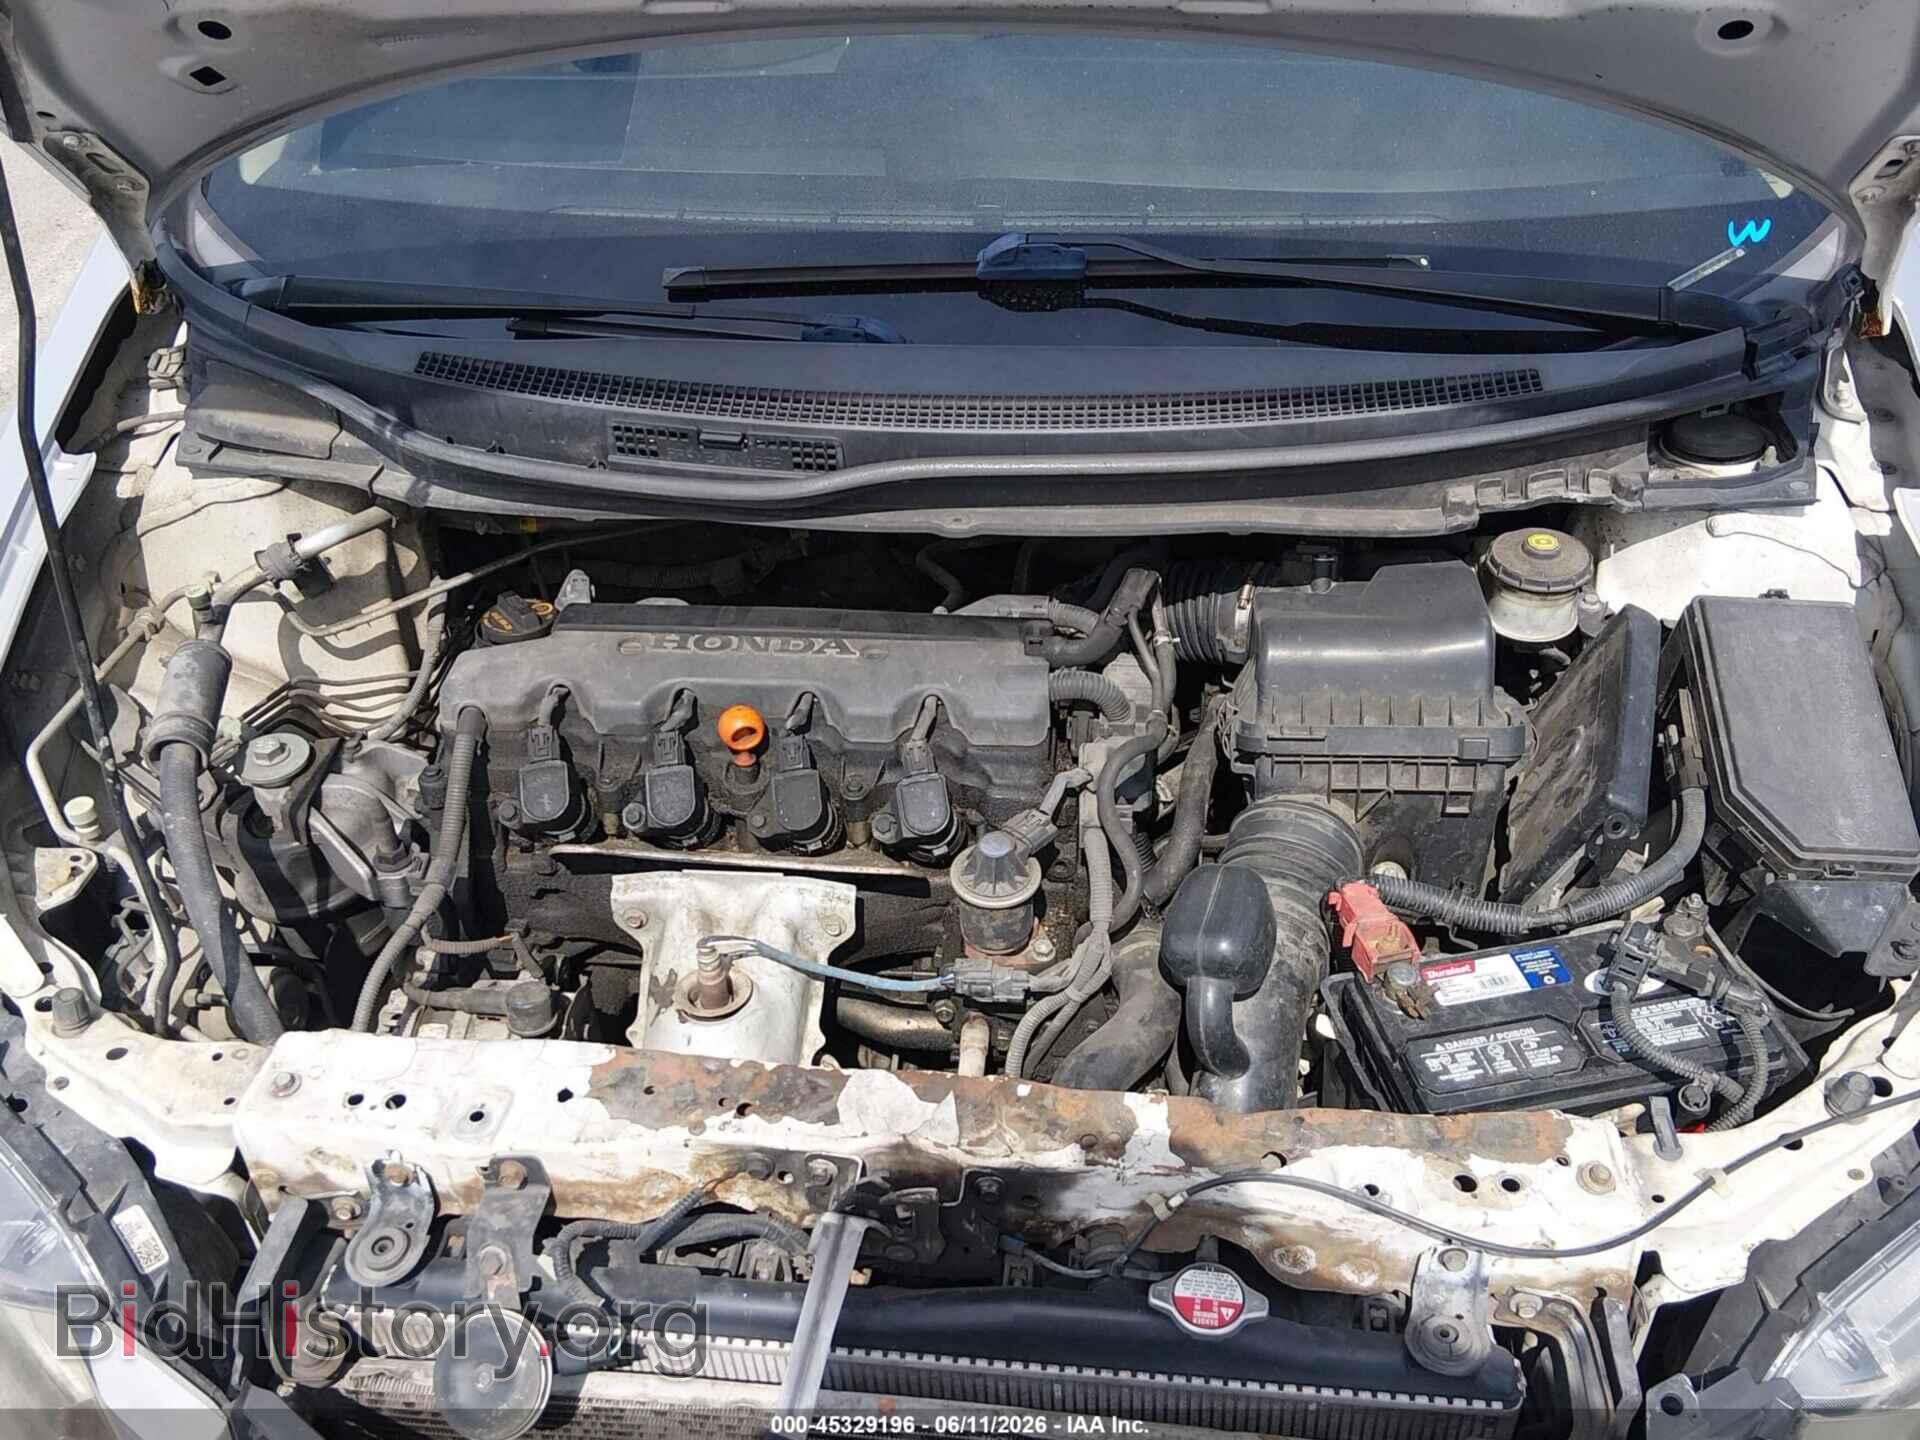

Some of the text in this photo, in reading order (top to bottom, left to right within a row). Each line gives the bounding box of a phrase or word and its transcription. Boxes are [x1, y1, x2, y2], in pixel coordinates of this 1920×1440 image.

[646, 633, 860, 659] HONDA
[1426, 964, 1472, 979] Duralast
[1444, 1035, 1488, 1051] DANGER
[1496, 1027, 1536, 1040] POISON
